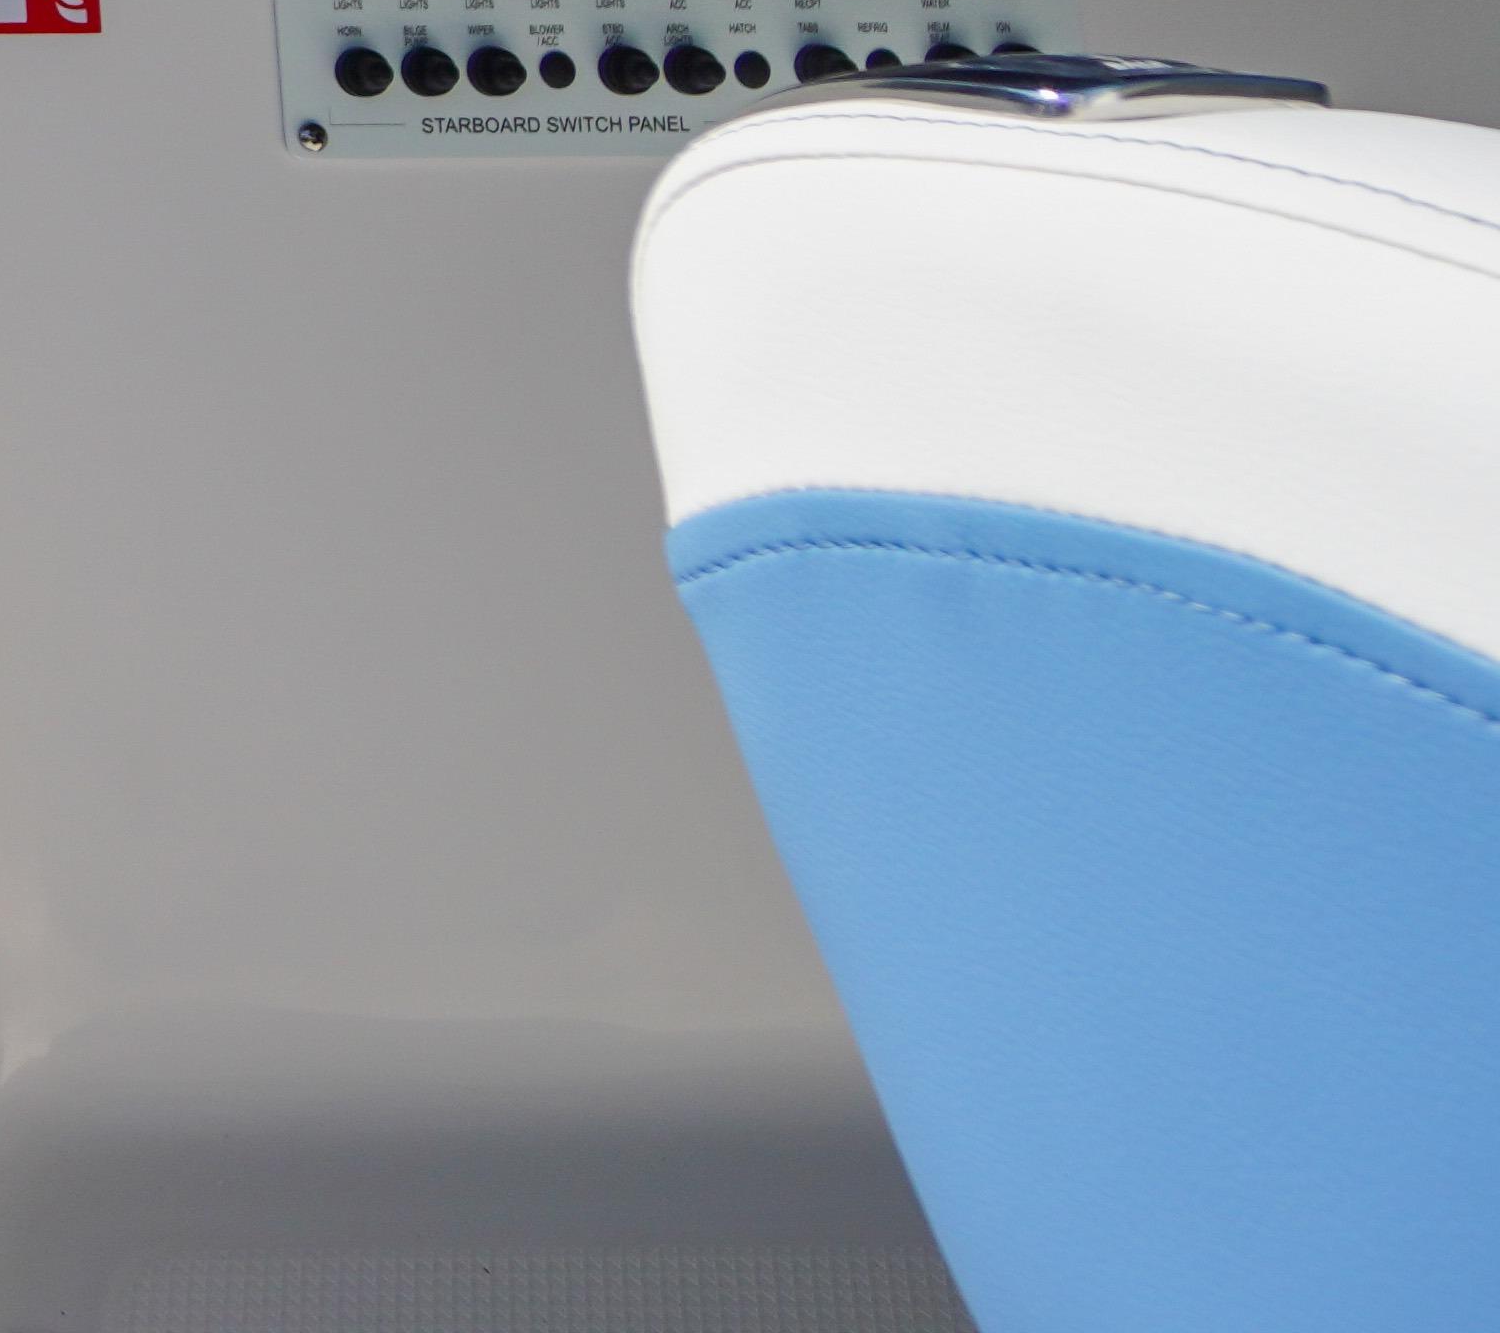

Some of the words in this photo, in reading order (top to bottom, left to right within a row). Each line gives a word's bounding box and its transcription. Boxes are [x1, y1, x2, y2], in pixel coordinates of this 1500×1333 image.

[333, 0, 363, 10] LIGHTS
[399, 0, 429, 10] LIGHTS
[465, 0, 494, 10] LIGHTS
[531, 0, 560, 9] LIGHTS
[670, 0, 687, 10] ACC
[735, 0, 752, 9] ACC
[337, 26, 361, 36] HORN
[468, 25, 494, 35] WIPER
[530, 25, 564, 35] BLOWER
[666, 24, 689, 34] ARCH
[729, 23, 756, 33] HATCH
[858, 22, 888, 33] REFRIG
[928, 22, 950, 33] HELM
[996, 22, 1011, 33] IGN
[421, 116, 541, 134] STARBOARD
[546, 116, 622, 133] SWITCH
[628, 115, 690, 132] PANEL
